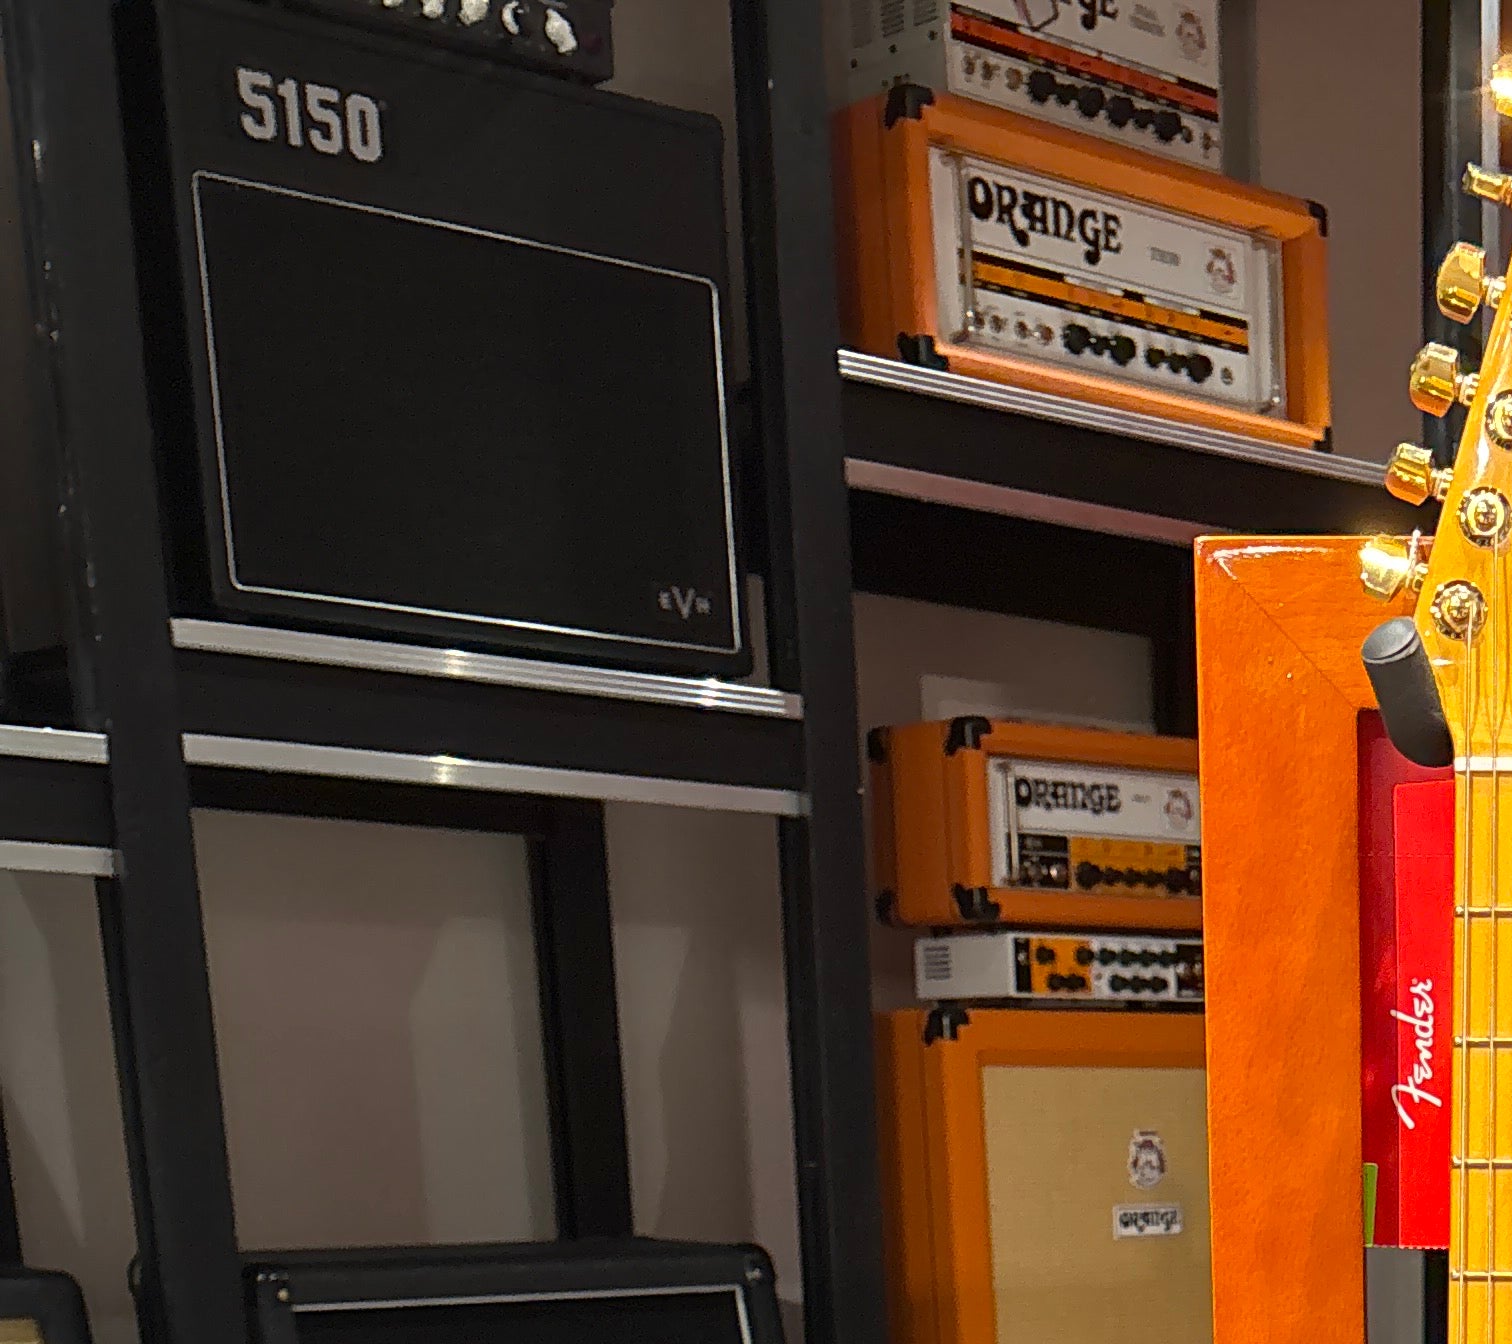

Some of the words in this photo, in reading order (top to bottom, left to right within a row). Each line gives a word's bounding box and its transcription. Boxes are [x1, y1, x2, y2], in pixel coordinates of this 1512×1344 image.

[236, 66, 384, 163] 5150
[967, 176, 1122, 266] ORANGE
[1014, 775, 1122, 815] ORANGE
